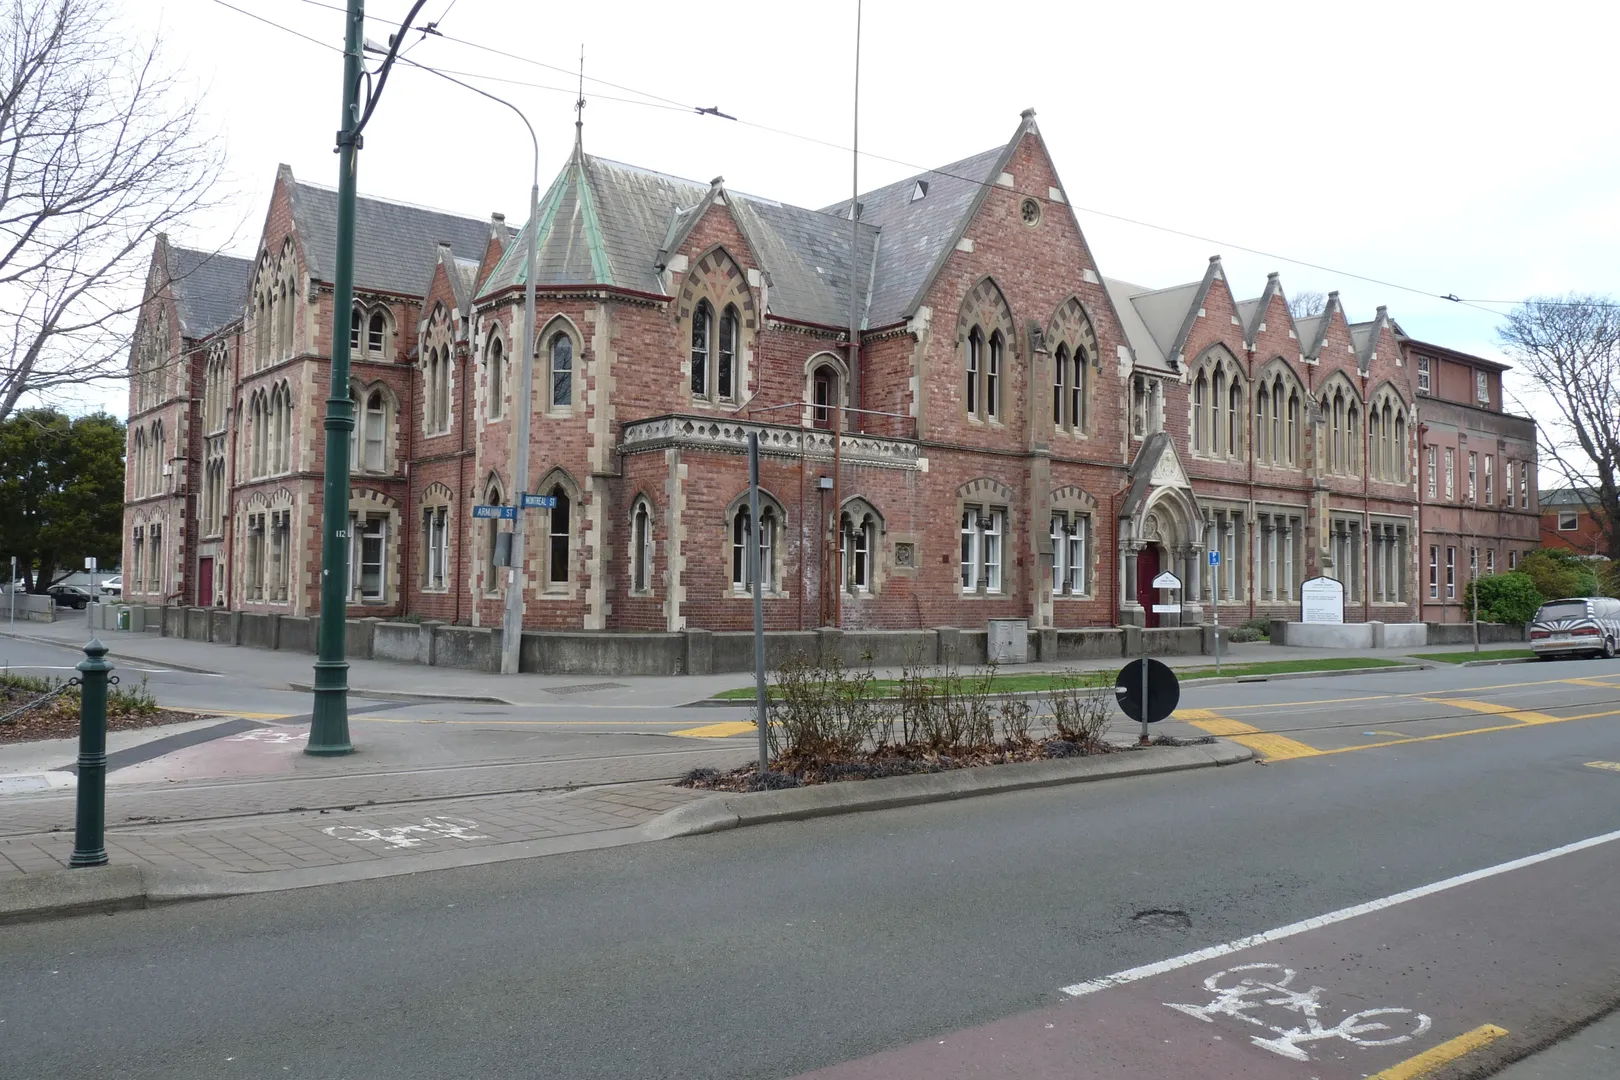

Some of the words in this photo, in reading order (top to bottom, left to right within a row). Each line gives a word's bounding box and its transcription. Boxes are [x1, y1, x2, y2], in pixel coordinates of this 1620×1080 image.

[525, 496, 547, 506] MONTREAL
[549, 498, 556, 506] ST
[477, 507, 502, 518] ARM
[506, 508, 513, 517] ST
[336, 530, 346, 538] 112
